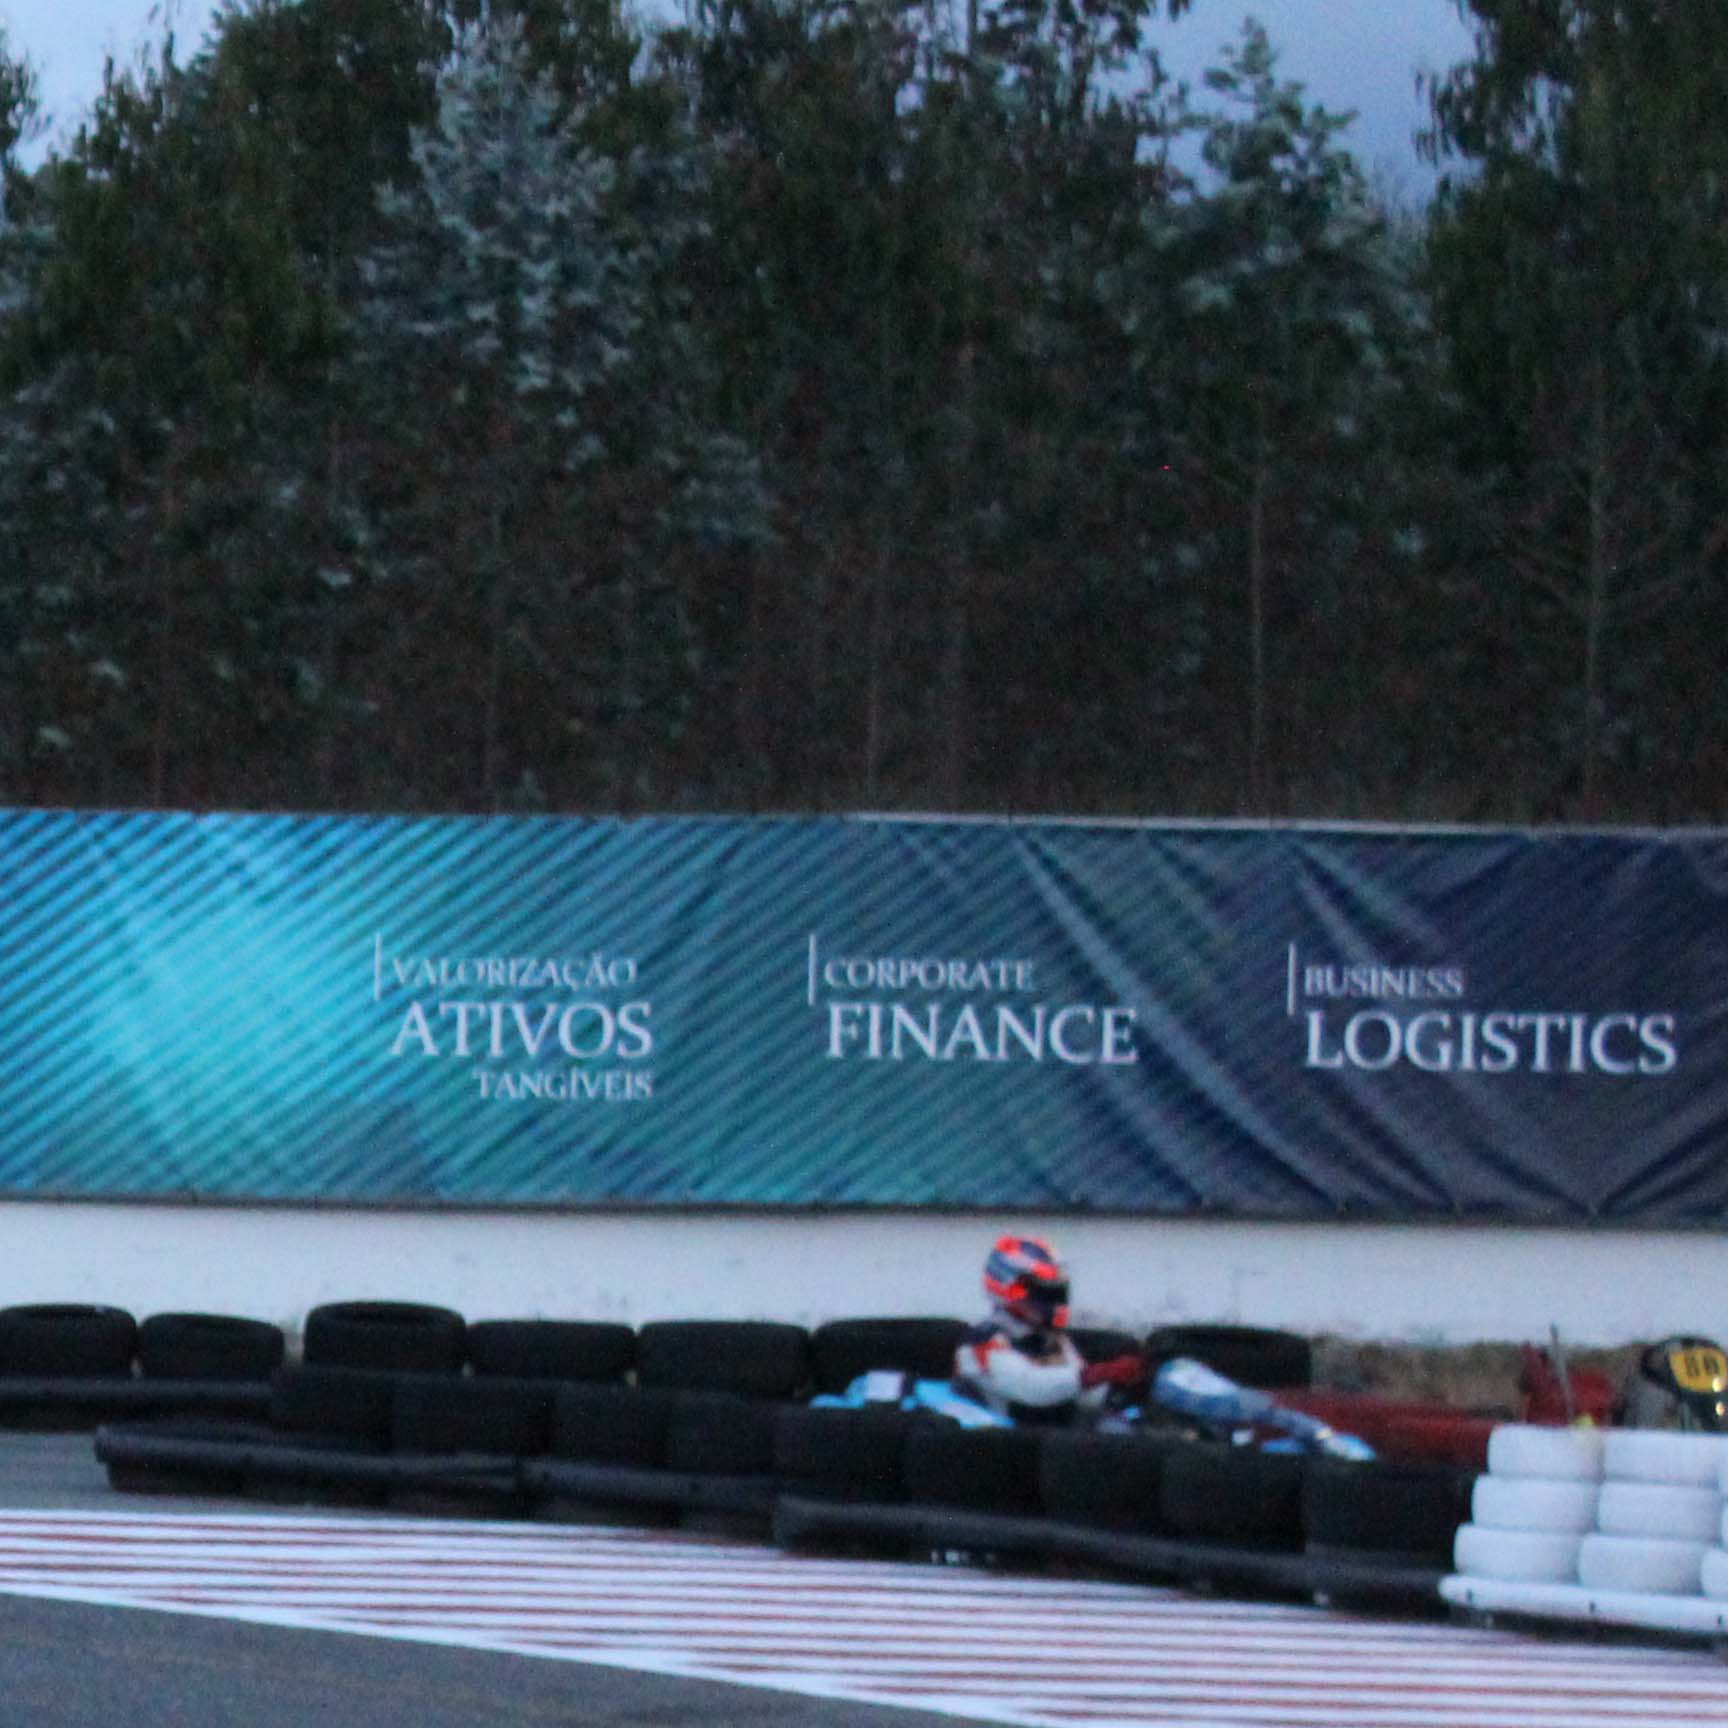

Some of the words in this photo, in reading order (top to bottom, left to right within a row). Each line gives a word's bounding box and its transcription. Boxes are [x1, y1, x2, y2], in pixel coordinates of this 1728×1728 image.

[393, 951, 638, 991] VALORIZAÇÃO
[824, 958, 1034, 991] CORPORATE
[1304, 965, 1464, 997] BUSINESS
[390, 1000, 654, 1060] ATIVOS
[826, 1002, 1139, 1065] FINANCE
[1304, 1009, 1678, 1075] LOGISTICS
[473, 1066, 655, 1100] TANGÍVEIS
